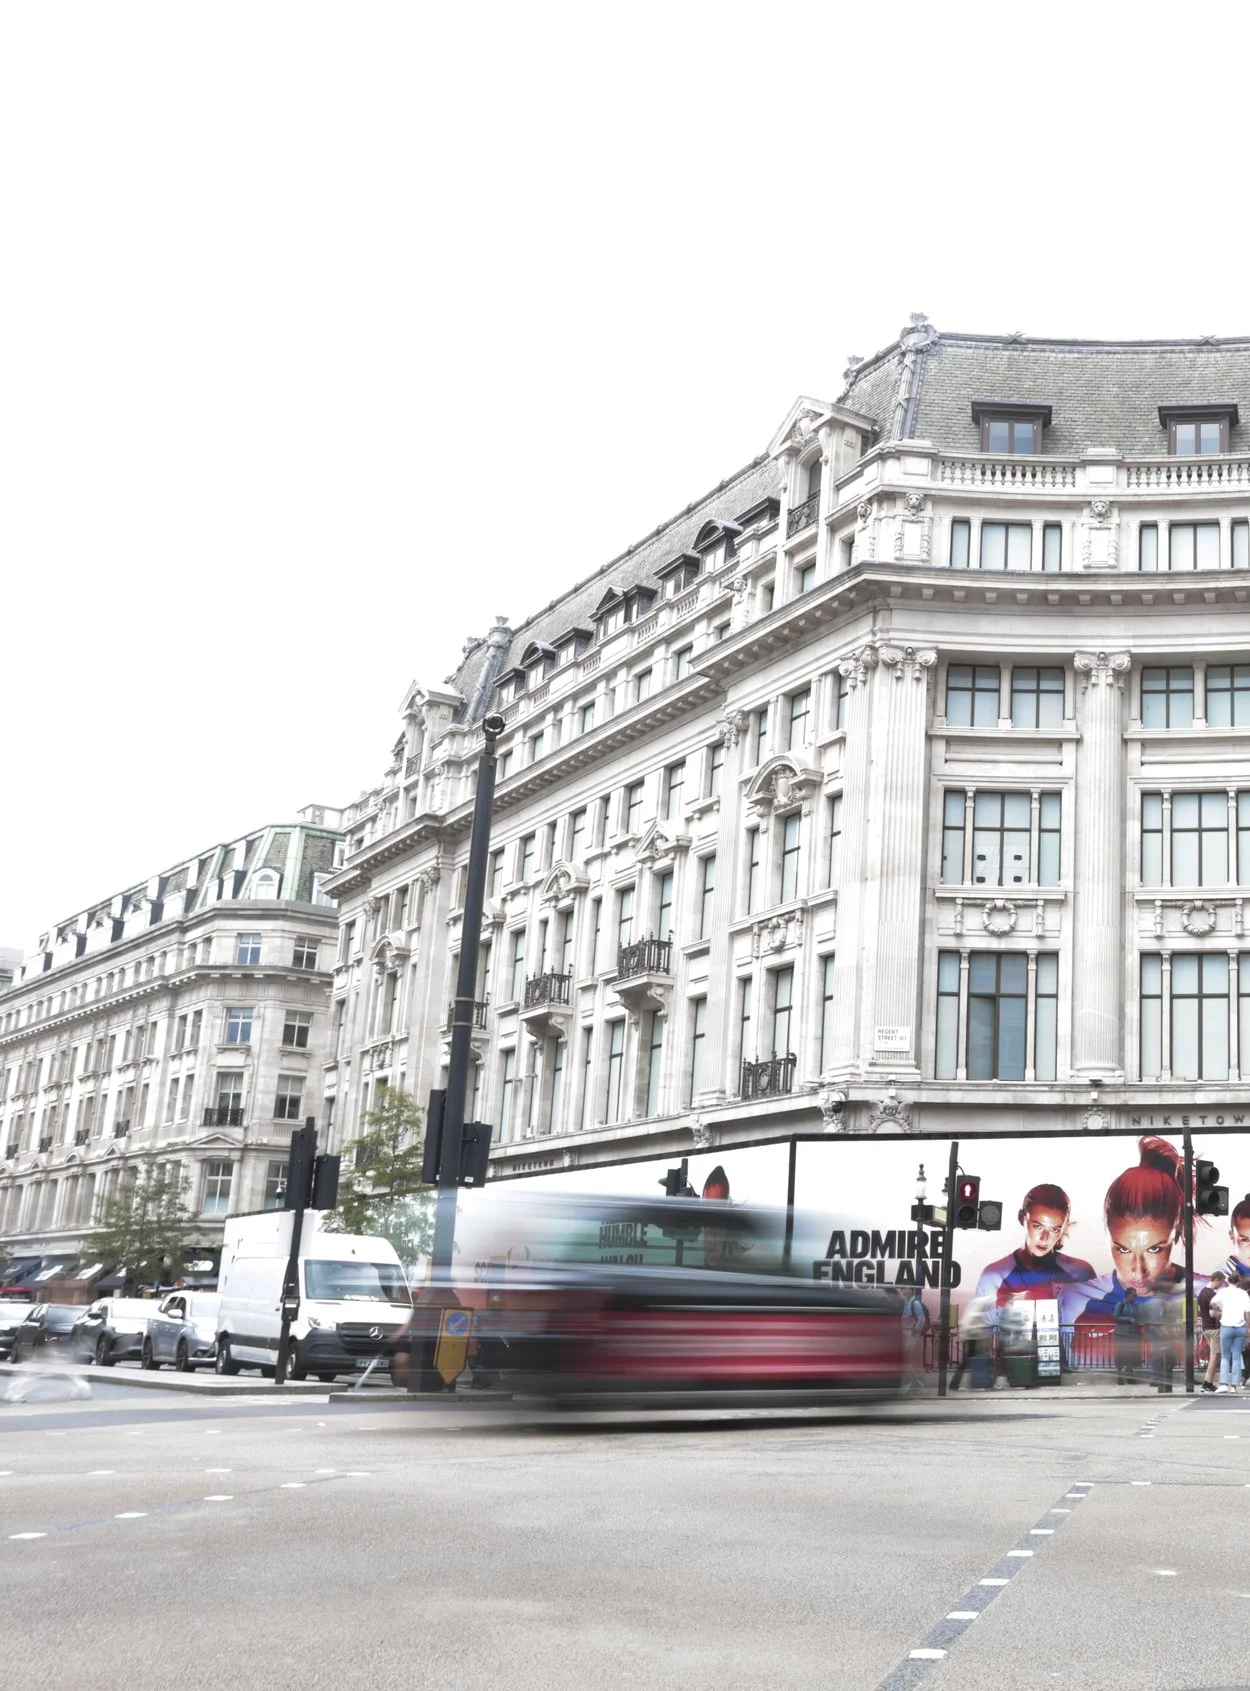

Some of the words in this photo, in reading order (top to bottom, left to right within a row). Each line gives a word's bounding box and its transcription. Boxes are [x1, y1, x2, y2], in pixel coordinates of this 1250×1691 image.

[599, 1222, 648, 1249] HUMBLE
[826, 1230, 946, 1259] ADMIRE
[813, 1260, 962, 1290] ENGLAND
